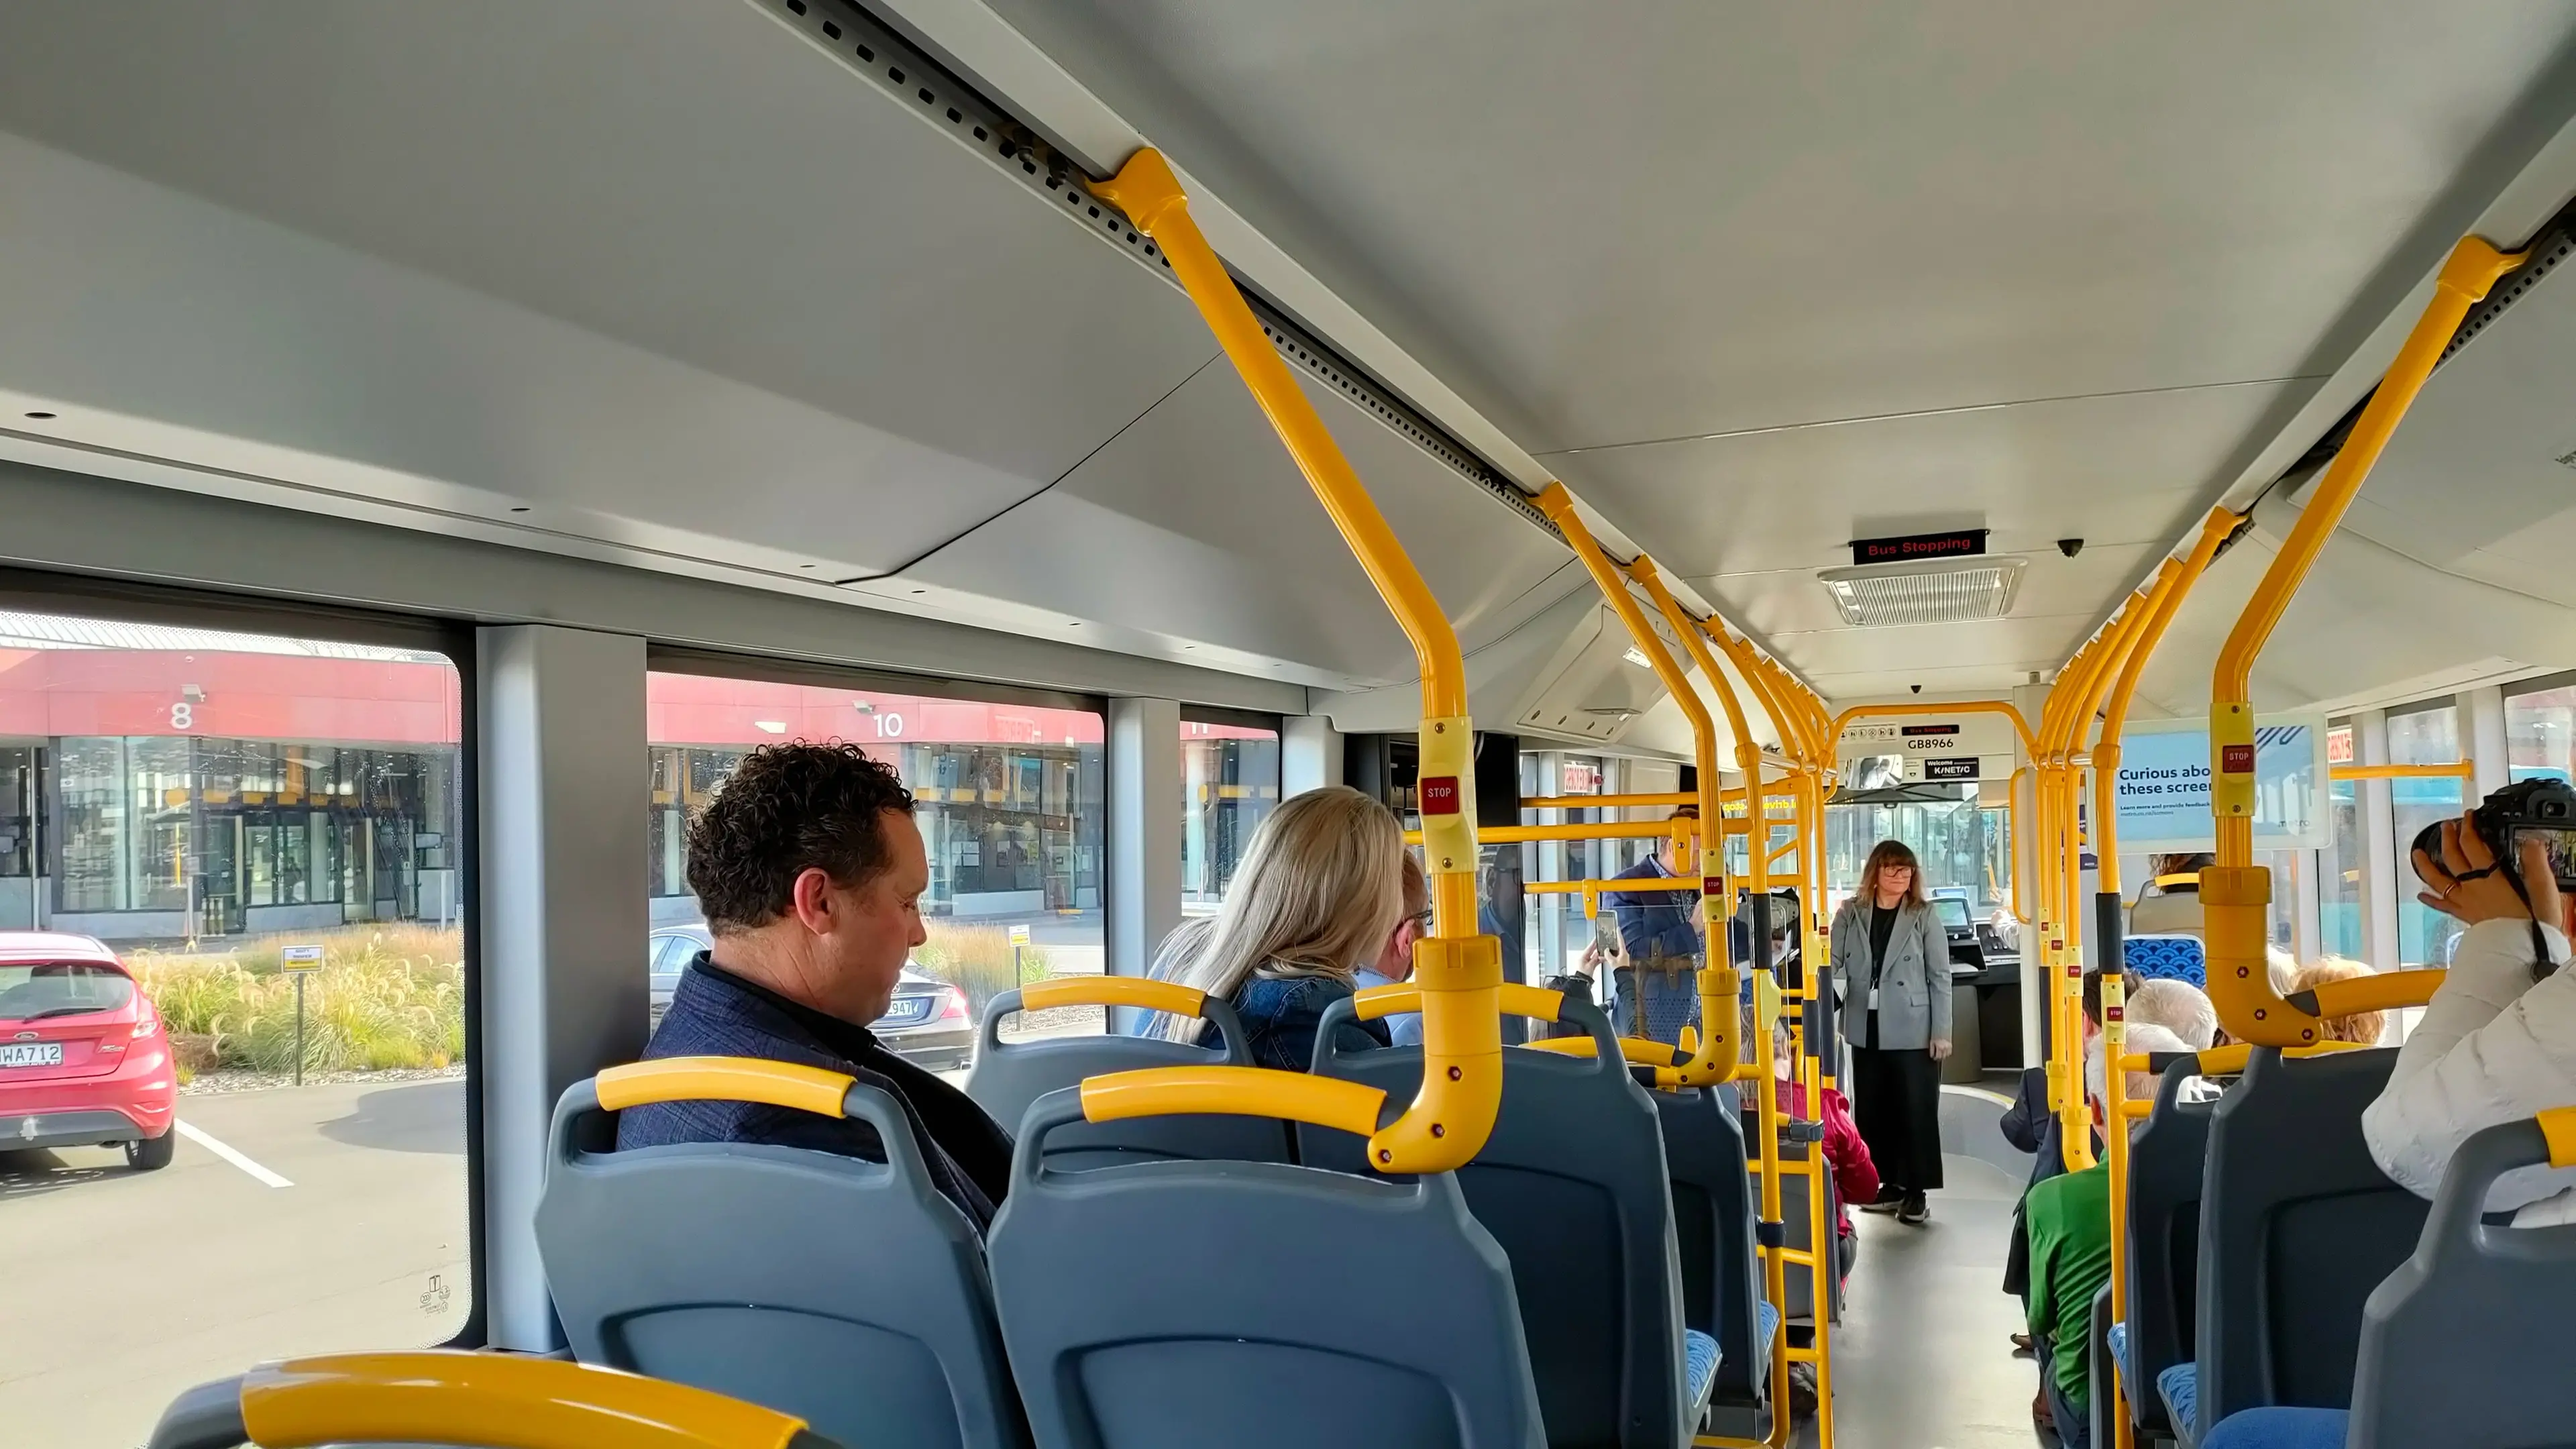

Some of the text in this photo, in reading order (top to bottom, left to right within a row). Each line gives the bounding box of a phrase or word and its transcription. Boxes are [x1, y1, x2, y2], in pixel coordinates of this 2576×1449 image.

[1868, 539, 1971, 556] Bus Stopping
[171, 702, 192, 730] 8
[873, 712, 903, 738] 10
[1908, 739, 1953, 749] GB8966
[2229, 752, 2249, 761] STOP
[2119, 764, 2211, 780] Curious abo
[1428, 787, 1451, 798] STOP
[2119, 782, 2212, 795] these scree
[0, 1046, 60, 1063] WA712
